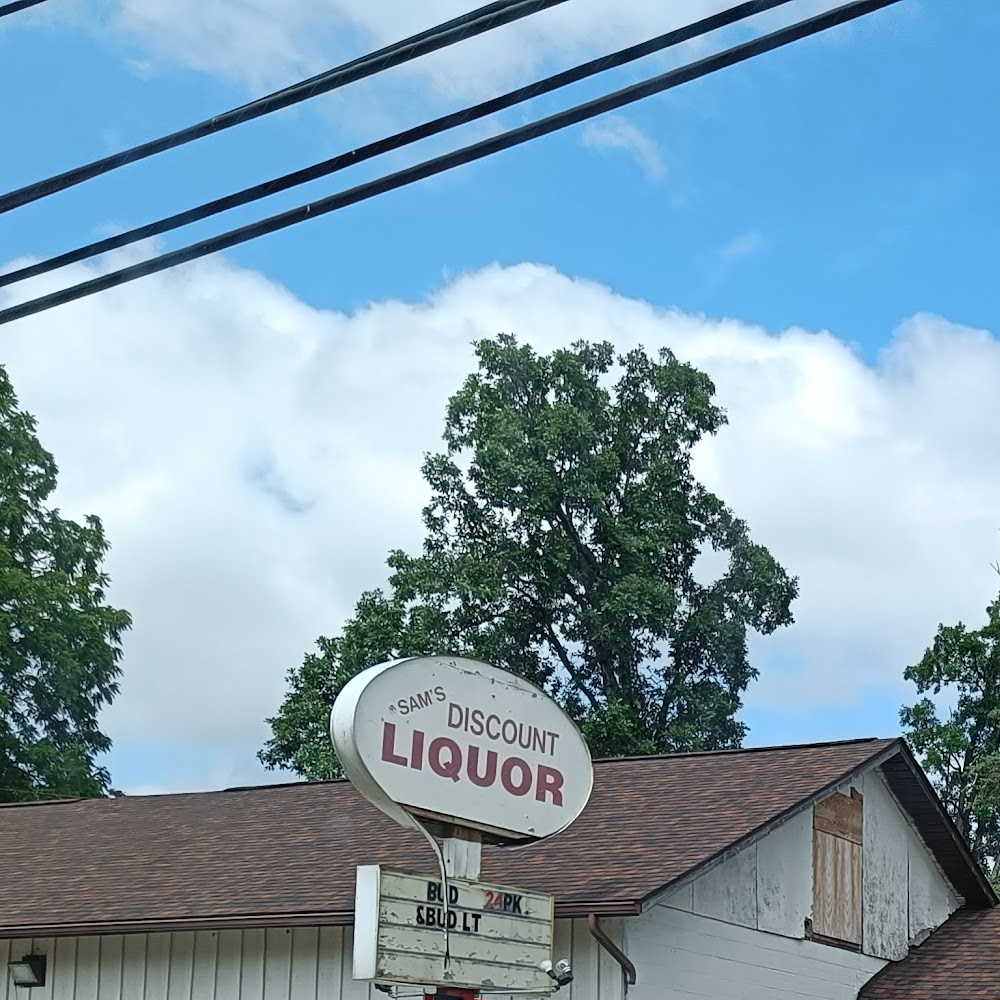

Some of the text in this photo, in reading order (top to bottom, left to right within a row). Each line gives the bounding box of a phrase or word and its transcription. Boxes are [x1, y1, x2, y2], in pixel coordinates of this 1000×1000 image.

[447, 702, 560, 756] DISCOUNT
[381, 721, 565, 807] LIQUOR
[427, 881, 459, 904] BUD
[462, 914, 482, 932] LT
